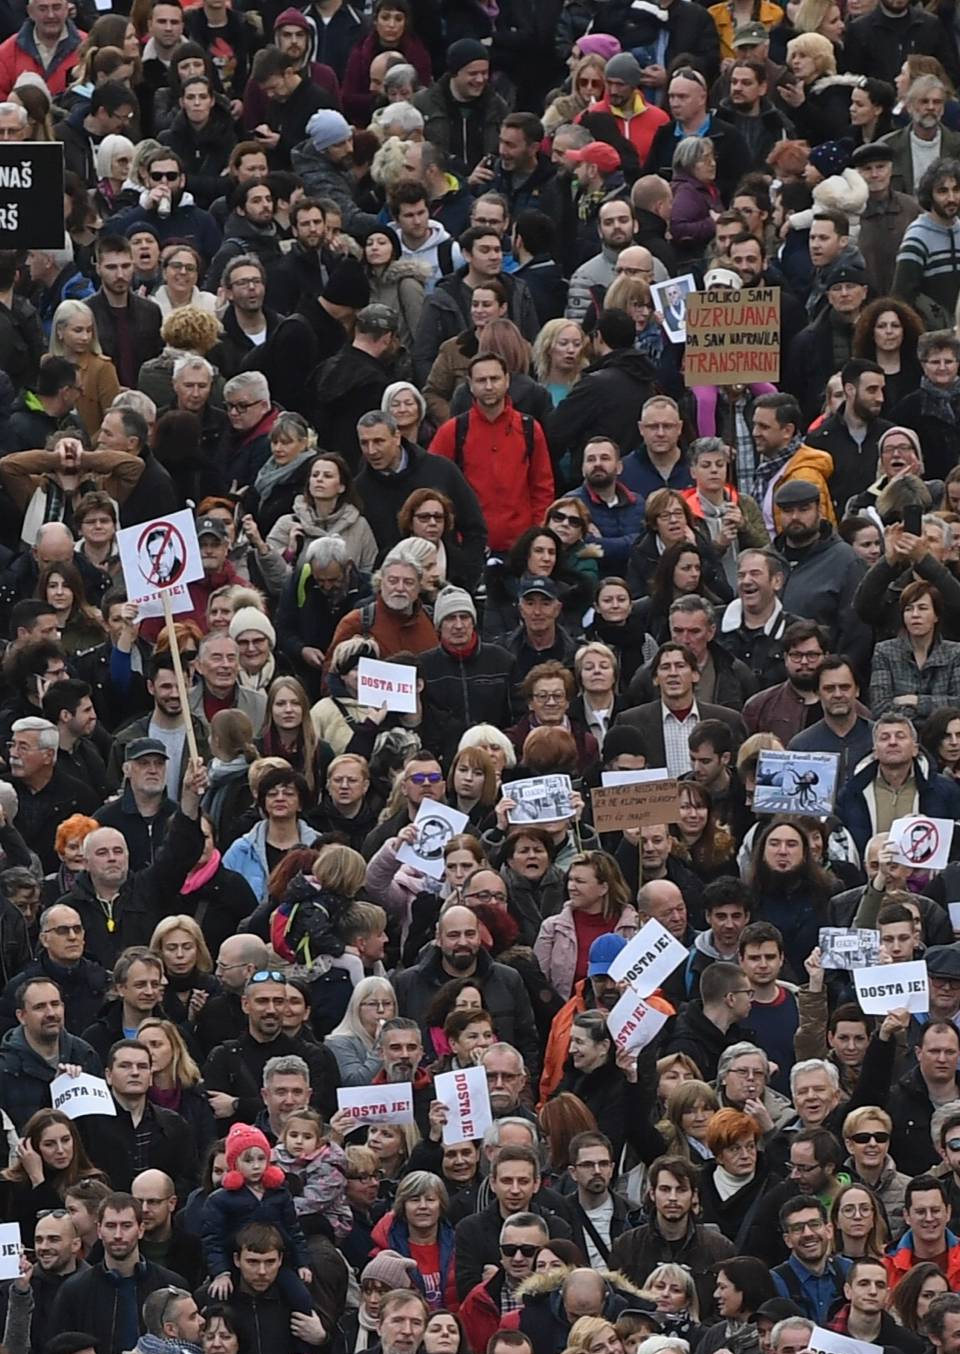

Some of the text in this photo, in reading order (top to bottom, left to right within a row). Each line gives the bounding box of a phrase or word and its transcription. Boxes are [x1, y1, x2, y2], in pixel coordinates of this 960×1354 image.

[748, 290, 773, 302] SAM
[687, 306, 778, 327] UZRUJANA
[360, 676, 413, 694] DOSTA JE!
[654, 933, 673, 954] JE!
[860, 979, 926, 998] DOSTA JE!
[54, 1086, 109, 1109] DOSTA JE!
[391, 1100, 410, 1114] JE!
[455, 1073, 474, 1138] DOSTA JE!
[2, 1243, 20, 1257] JE!
